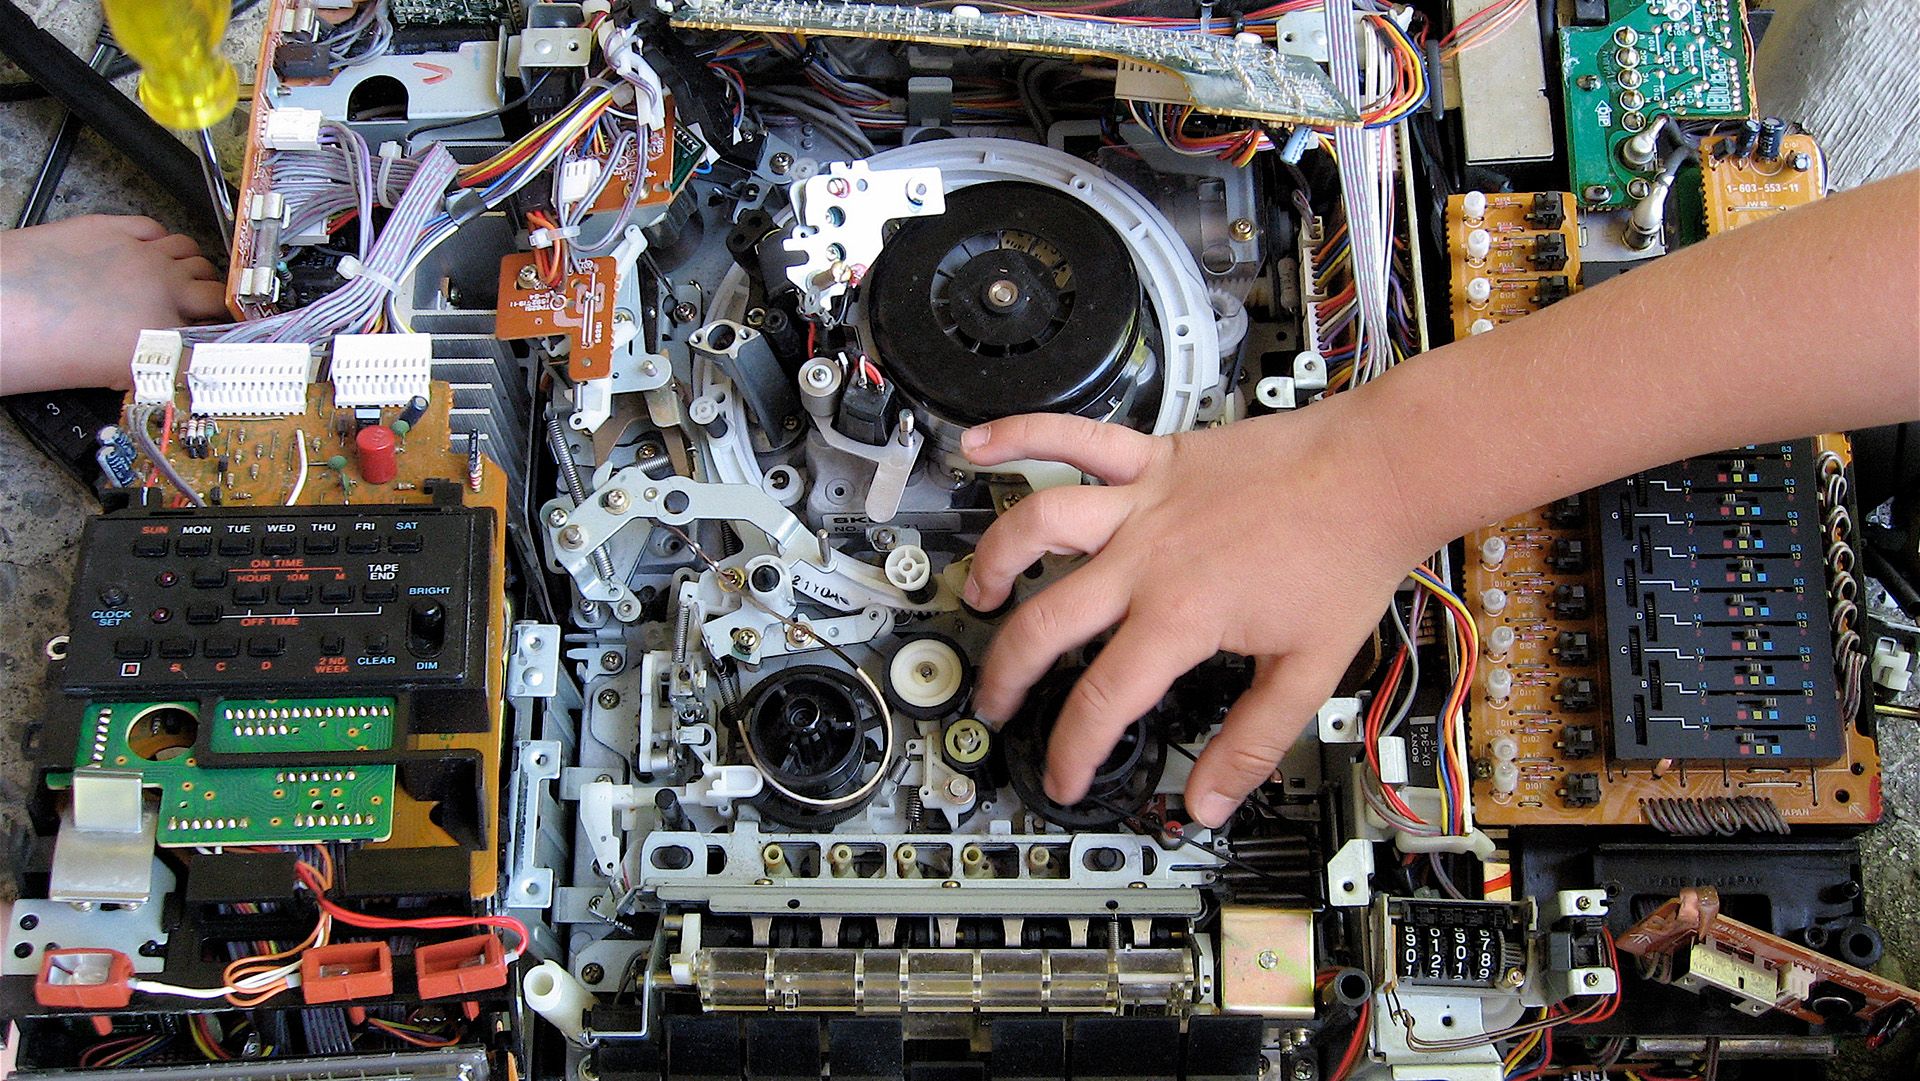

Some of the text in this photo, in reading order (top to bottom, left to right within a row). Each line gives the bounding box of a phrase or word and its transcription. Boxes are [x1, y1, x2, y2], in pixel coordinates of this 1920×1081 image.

[1640, 49, 1648, 65] AGC
[1642, 72, 1649, 83] VC
[1727, 183, 1799, 193] 1-603-553-11
[46, 402, 60, 416] 3
[72, 425, 88, 439] 2
[141, 526, 169, 535] SUN
[182, 525, 212, 534] MON
[227, 525, 250, 533] TUE
[267, 524, 296, 533] WED
[311, 523, 336, 532] THU
[355, 522, 375, 531] FRI
[395, 522, 418, 530] SAT
[250, 559, 304, 568] ON TIME
[368, 563, 399, 572] TAPE
[237, 574, 272, 582] HOUR
[287, 573, 310, 581] 10M
[370, 572, 396, 580] END
[409, 586, 450, 595] BRIGHT
[91, 610, 132, 619] CLOCK
[99, 618, 121, 627] SET
[240, 617, 300, 626] OFF TIME
[1620, 646, 1628, 654] C
[357, 656, 396, 665] CLEAR
[216, 661, 226, 671] C
[261, 661, 271, 670] D
[315, 665, 350, 674] WEEK
[416, 661, 438, 670] DIM
[1642, 680, 1648, 688] B
[1411, 731, 1420, 763] SONY
[1525, 782, 1542, 790] D101
